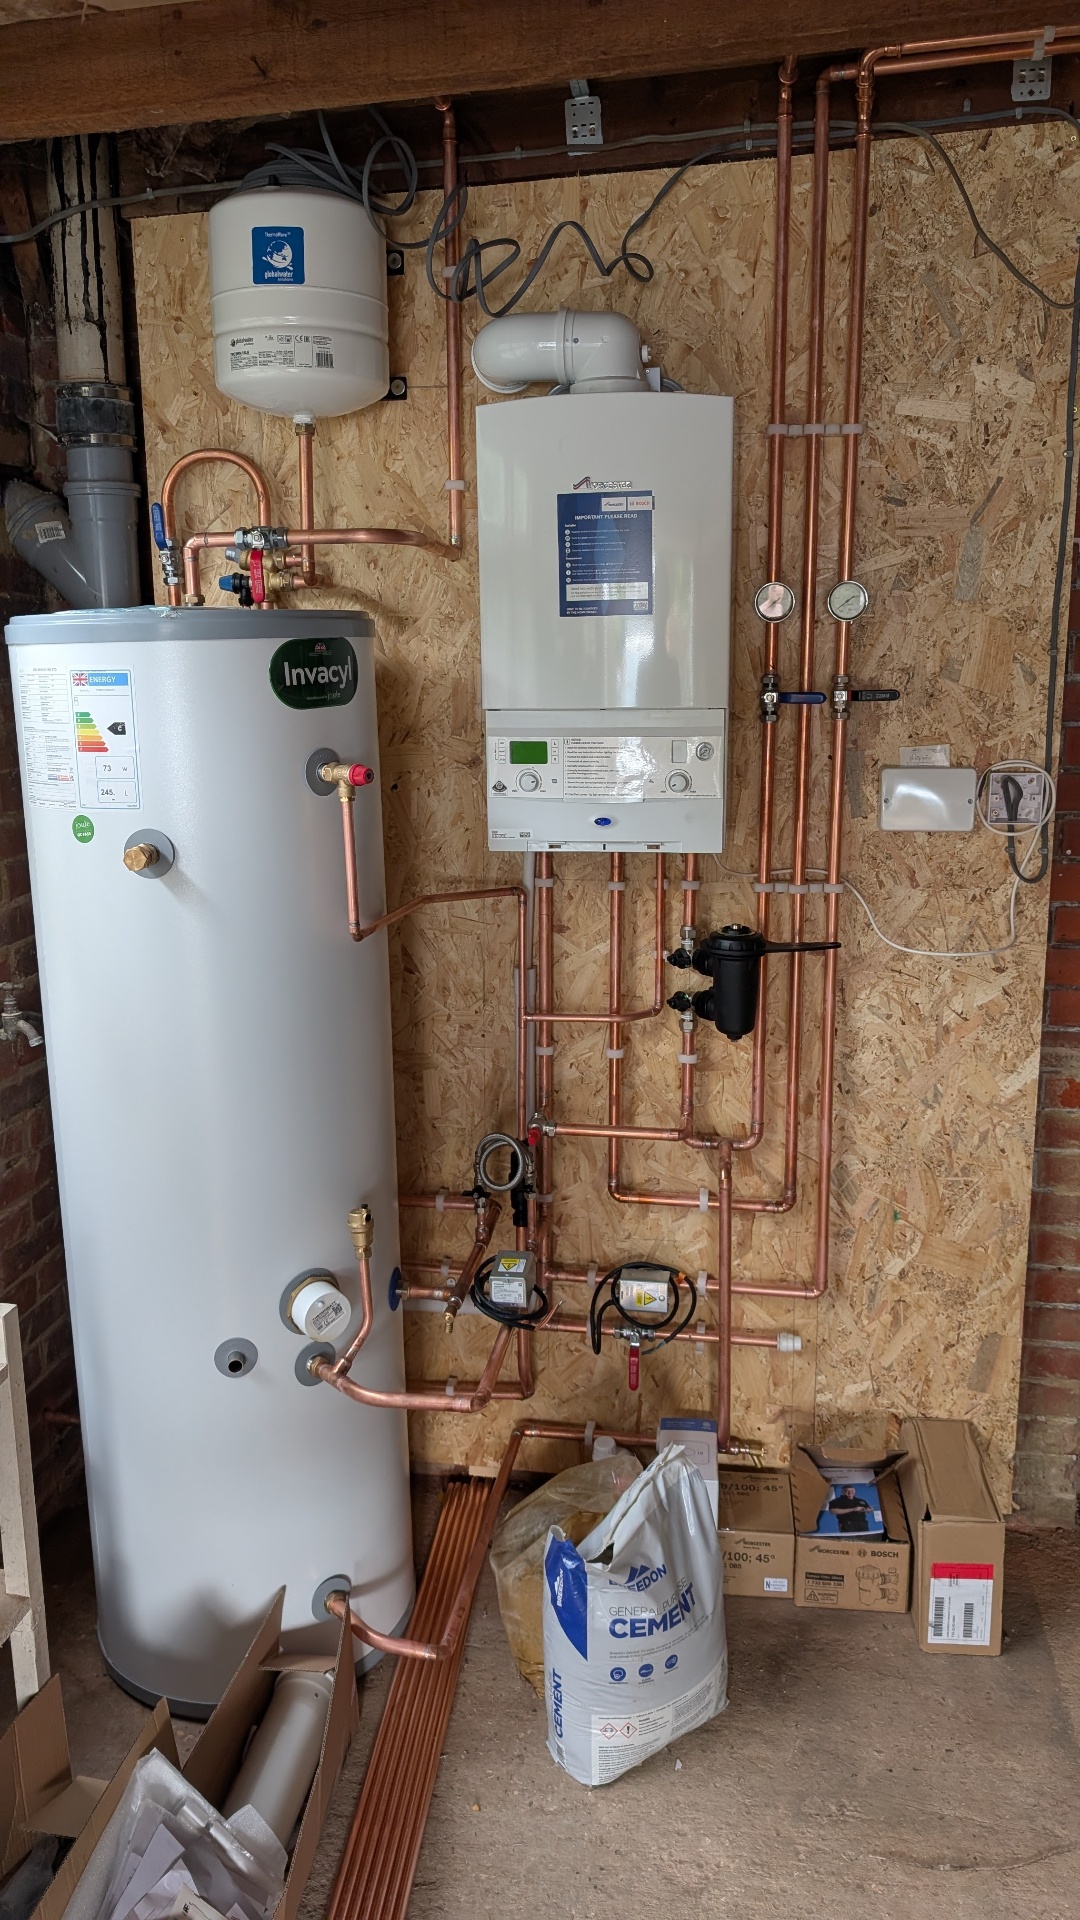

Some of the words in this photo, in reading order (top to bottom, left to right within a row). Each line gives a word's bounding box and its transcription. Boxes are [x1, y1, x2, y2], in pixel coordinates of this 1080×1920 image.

[264, 270, 294, 280] globalwater
[283, 655, 353, 689] Invacyl
[720, 1483, 760, 1492] 0/100;
[722, 1550, 752, 1563] /100;
[755, 1553, 776, 1563] 45°
[816, 1548, 850, 1556] WORCESTER
[870, 1550, 899, 1558] BOSCH
[556, 1568, 564, 1607] BREEDON
[609, 1563, 667, 1592] EEDON
[608, 1582, 696, 1639] CEMENT
[608, 1606, 663, 1617] GENERAL
[552, 1667, 564, 1739] CEMENT
